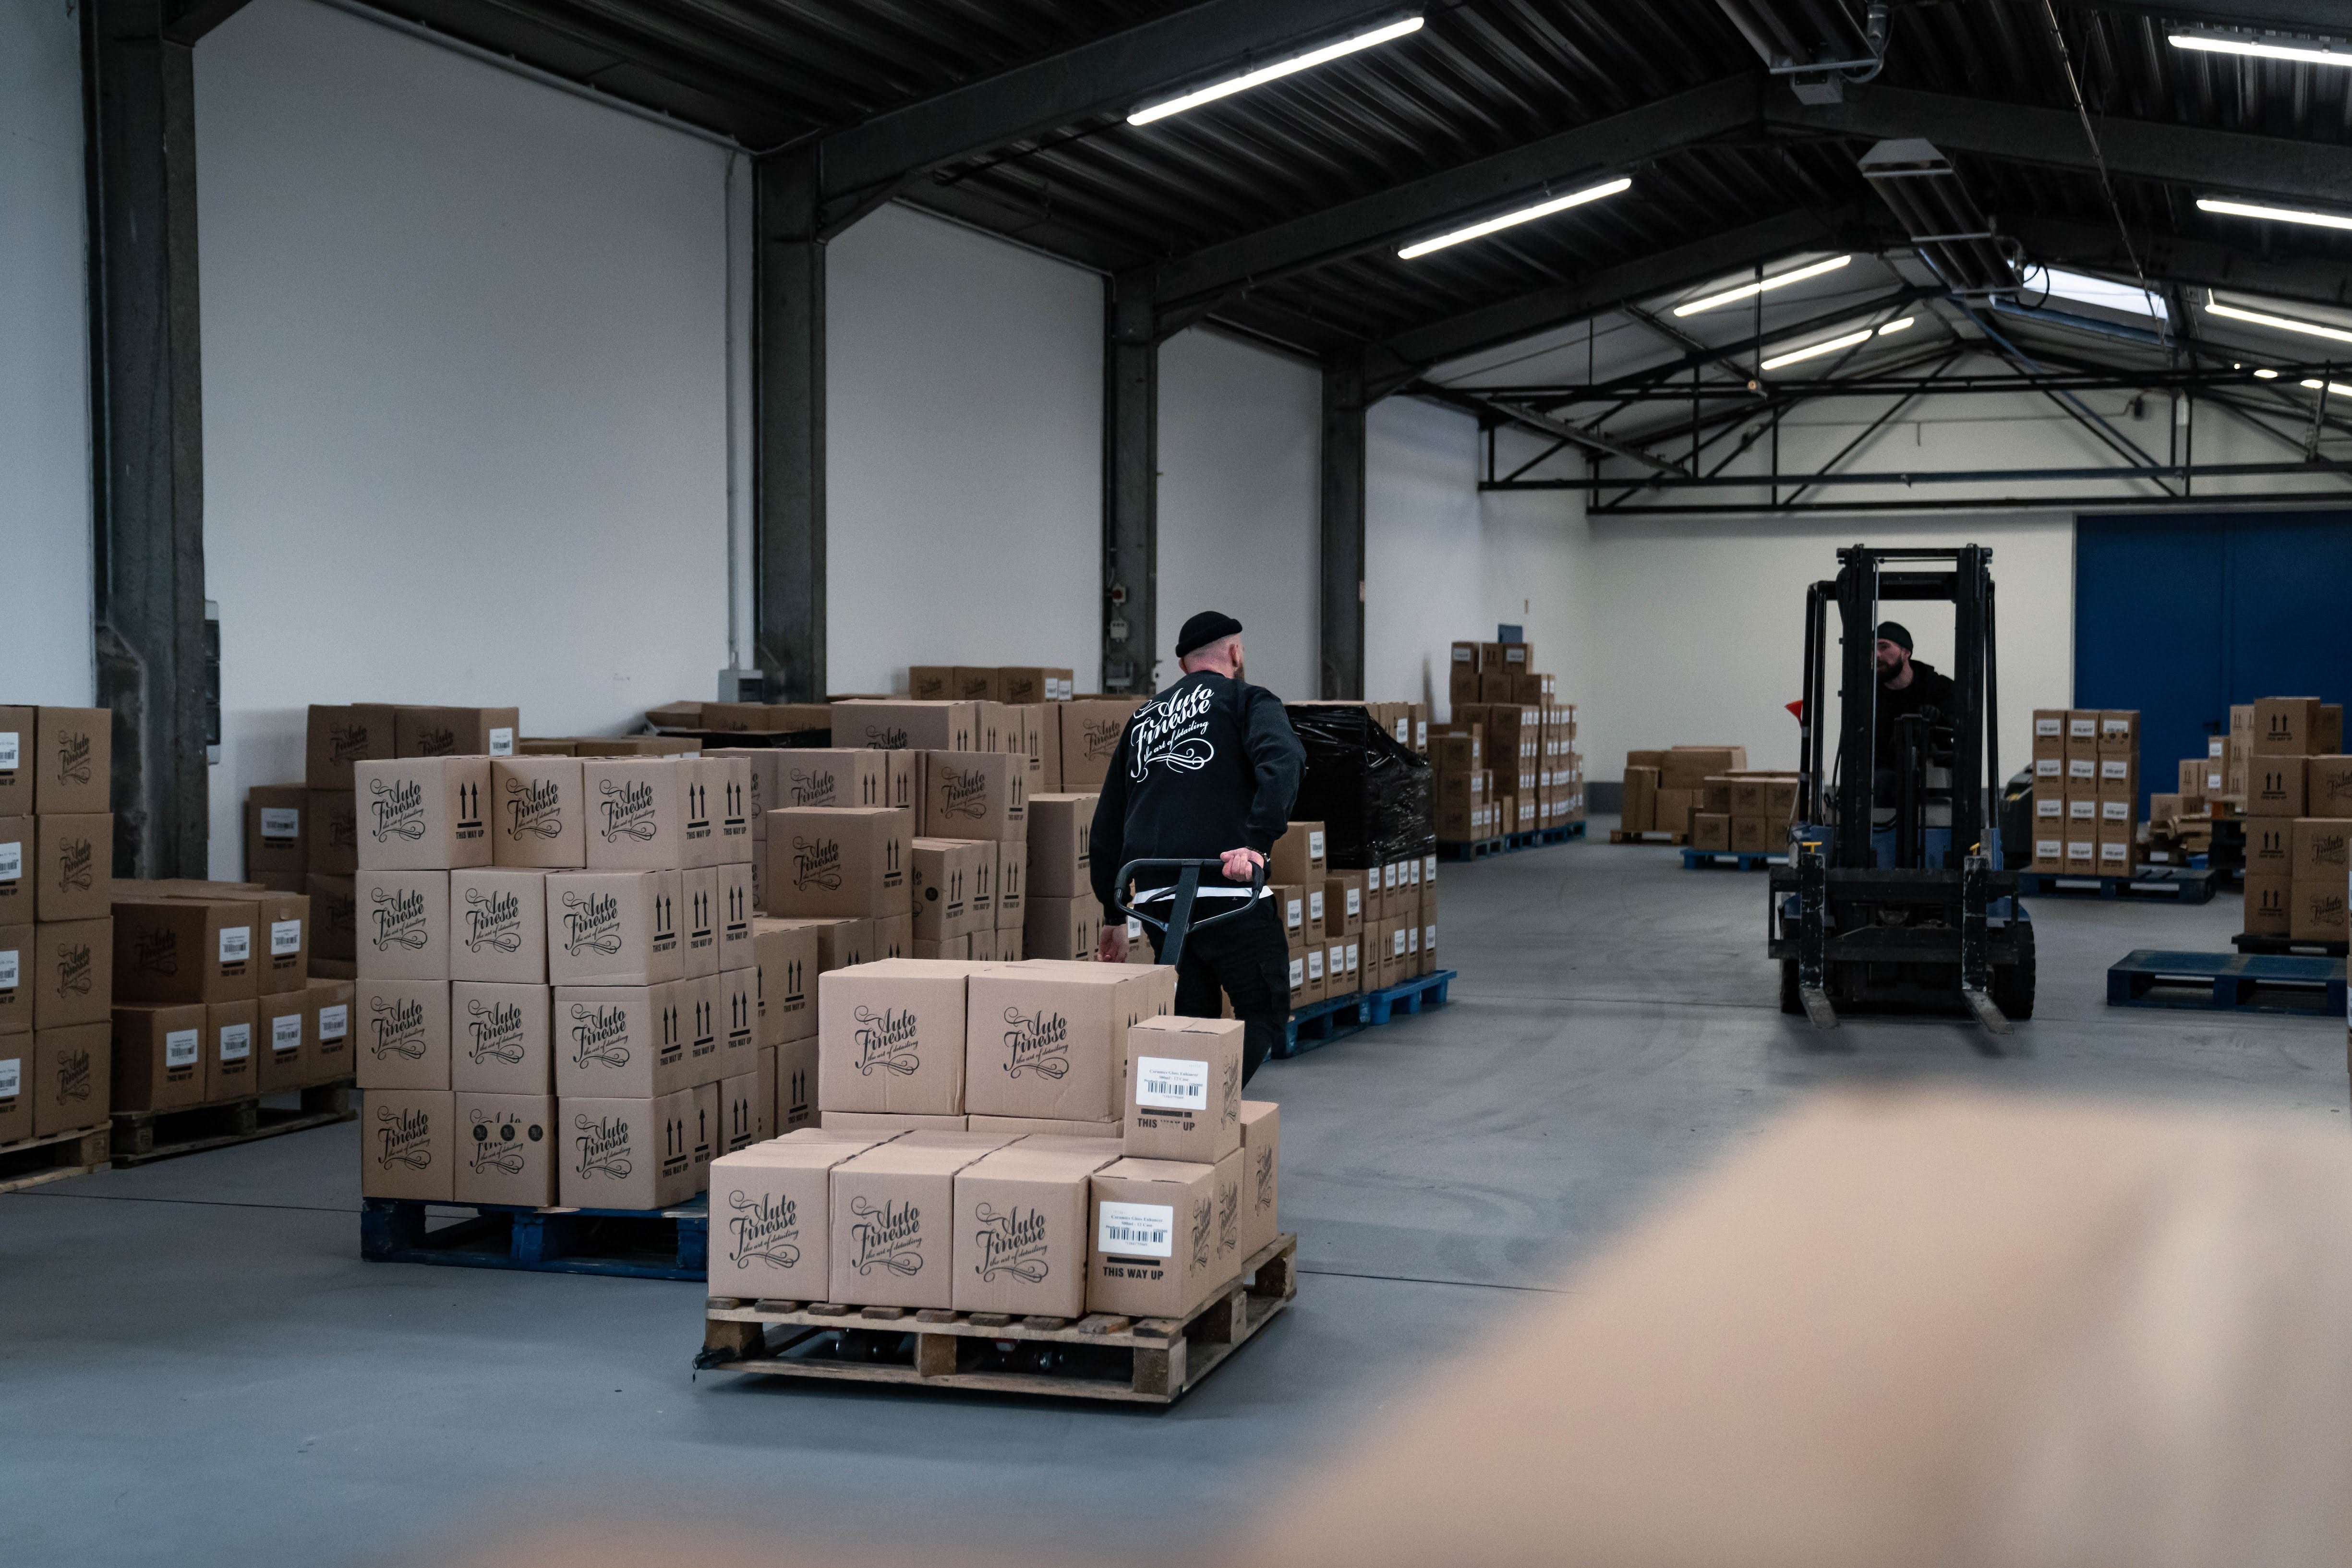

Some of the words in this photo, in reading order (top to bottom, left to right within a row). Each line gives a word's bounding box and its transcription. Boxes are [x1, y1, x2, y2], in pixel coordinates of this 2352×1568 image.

[1134, 684, 1214, 728] Auto
[1131, 699, 1210, 778] Finesse
[1144, 746, 1152, 762] the
[1154, 741, 1166, 753] art
[1167, 730, 1176, 751] of
[1175, 720, 1209, 740] detailing
[370, 779, 421, 808] Auto
[506, 778, 558, 807] Auto
[599, 780, 652, 808] Auto
[941, 767, 986, 791] Auto
[941, 782, 985, 814] Finesse
[372, 794, 422, 837] Finesse
[507, 794, 558, 835] Finesse
[601, 796, 653, 837] Finesse
[456, 831, 466, 839] THIS
[687, 832, 695, 840] THIS
[696, 830, 704, 838] WAY
[793, 836, 839, 862] Auto
[793, 852, 839, 886] Finesse
[371, 888, 423, 917] Auto
[465, 888, 519, 918] Auto
[562, 892, 617, 921] Auto
[372, 904, 424, 945] Finesse
[466, 906, 519, 946] Finesse
[564, 908, 617, 950] Finesse
[662, 942, 670, 951] WAY
[671, 941, 676, 949] UP
[370, 996, 423, 1026] Auto
[468, 1000, 521, 1030] Auto
[571, 1004, 626, 1034] Auto
[854, 1005, 917, 1038] Auto
[1004, 1007, 1067, 1040] Auto
[371, 1014, 423, 1054] Finesse
[469, 1018, 521, 1058] Finesse
[572, 1021, 626, 1063] Finesse
[728, 1040, 736, 1049] THIS
[747, 1037, 751, 1045] UP
[855, 1025, 917, 1069] Finesse
[1003, 1028, 1067, 1071] Finesse
[660, 1057, 668, 1066] THIS
[868, 1052, 876, 1061] the
[887, 1045, 893, 1059] of
[893, 1040, 918, 1052] detailing
[1016, 1054, 1025, 1064] the
[1036, 1048, 1042, 1062] of
[1042, 1044, 1068, 1055] detailing
[377, 1106, 429, 1136] Auto
[575, 1114, 629, 1145] Auto
[1137, 1118, 1157, 1128] THIS
[1183, 1122, 1195, 1131] UP
[377, 1124, 428, 1164] Finesse
[576, 1133, 628, 1173] Finesse
[695, 1154, 703, 1163] WAY
[704, 1152, 710, 1160] UP
[663, 1168, 672, 1178] THIS
[673, 1165, 681, 1174] WAY
[683, 1163, 688, 1171] UP
[729, 1191, 797, 1227] Auto
[851, 1197, 920, 1234] Auto
[976, 1203, 1046, 1241] Auto
[729, 1212, 796, 1261] Finesse
[744, 1242, 753, 1253] the
[754, 1241, 763, 1249] art
[764, 1234, 771, 1251] of
[771, 1230, 799, 1242] detailing
[852, 1220, 920, 1268] Finesse
[866, 1249, 875, 1260] the
[887, 1242, 894, 1258] of
[894, 1237, 922, 1250] detailing
[976, 1227, 1046, 1275] Finesse
[990, 1256, 999, 1266] the
[1012, 1249, 1019, 1265] of
[1018, 1244, 1048, 1257] detailing
[1103, 1266, 1124, 1278] THIS
[1127, 1268, 1147, 1279] WAY
[1151, 1270, 1164, 1280] UP
